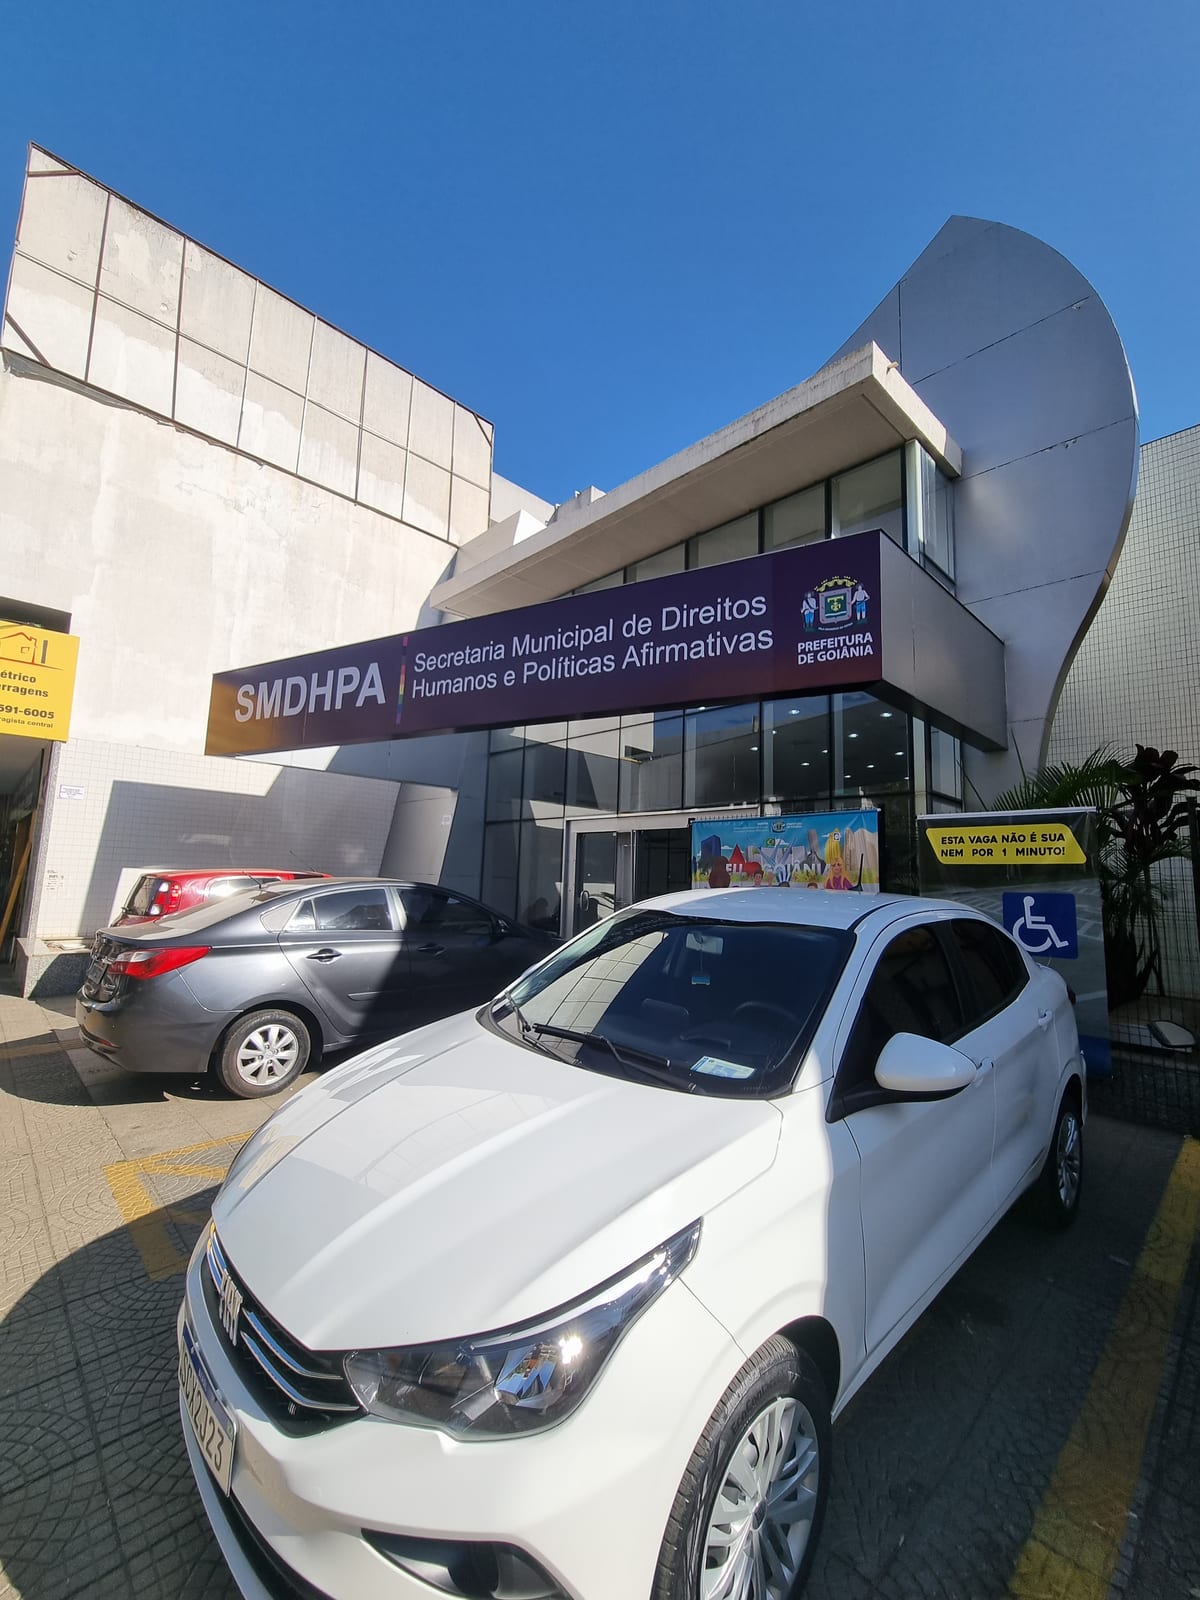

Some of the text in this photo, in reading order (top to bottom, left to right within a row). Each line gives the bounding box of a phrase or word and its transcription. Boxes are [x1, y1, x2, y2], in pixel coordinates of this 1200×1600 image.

[413, 595, 767, 673] Secretaria Municipal de Direitos
[797, 631, 873, 653] PREFEITURA
[411, 629, 774, 699] Humanos e Políticas Afirmativas
[797, 644, 874, 665] DE GOIÂNIA
[0, 683, 49, 697] rragens
[234, 662, 387, 723] SMDHPA
[27, 720, 54, 728] central
[941, 832, 1065, 845] ESTA VAGA NÃO É SUA
[941, 847, 1065, 857] NEM POR 1 MINUTO!
